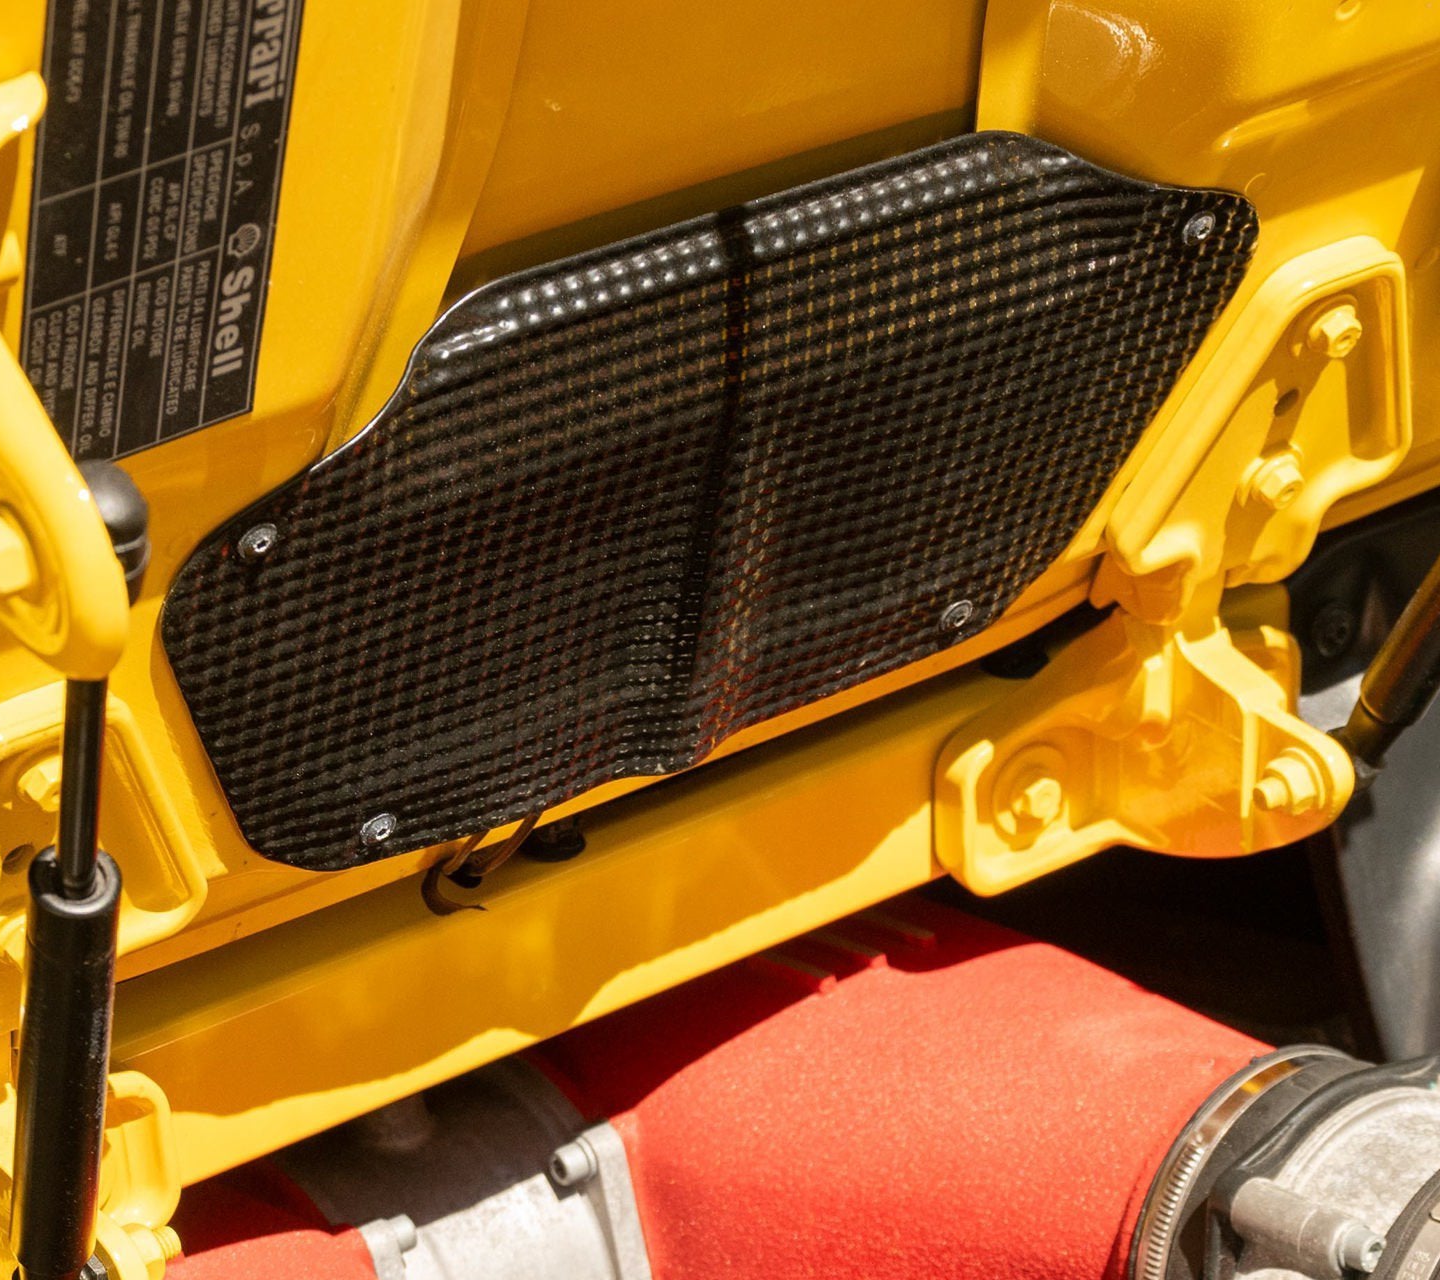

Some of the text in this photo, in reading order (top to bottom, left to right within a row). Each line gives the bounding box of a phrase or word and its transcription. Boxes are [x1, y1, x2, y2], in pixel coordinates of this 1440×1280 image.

[244, 0, 293, 108] rrari
[182, 154, 206, 253] SPECIFICATIONS
[203, 149, 223, 221] SPECIFICHE
[29, 317, 48, 365] CIRCUIT
[45, 310, 64, 360] CLUTCH
[59, 303, 81, 390] OLIO FRIZIONE
[86, 296, 106, 355] GEARBOX
[103, 289, 125, 378] DIFFERENZIALE
[131, 281, 151, 348] ENGINE OIL
[148, 275, 169, 358] OLIO MOTORE
[165, 265, 193, 415] PARTS TO BE LUBRICATED
[183, 259, 210, 392] PARTI DA LUBRIFICARE
[212, 265, 255, 377] Shell
[44, 360, 58, 387] AND
[84, 359, 99, 385] AND
[78, 433, 92, 452] OIL
[98, 392, 115, 438] CAMBIO
